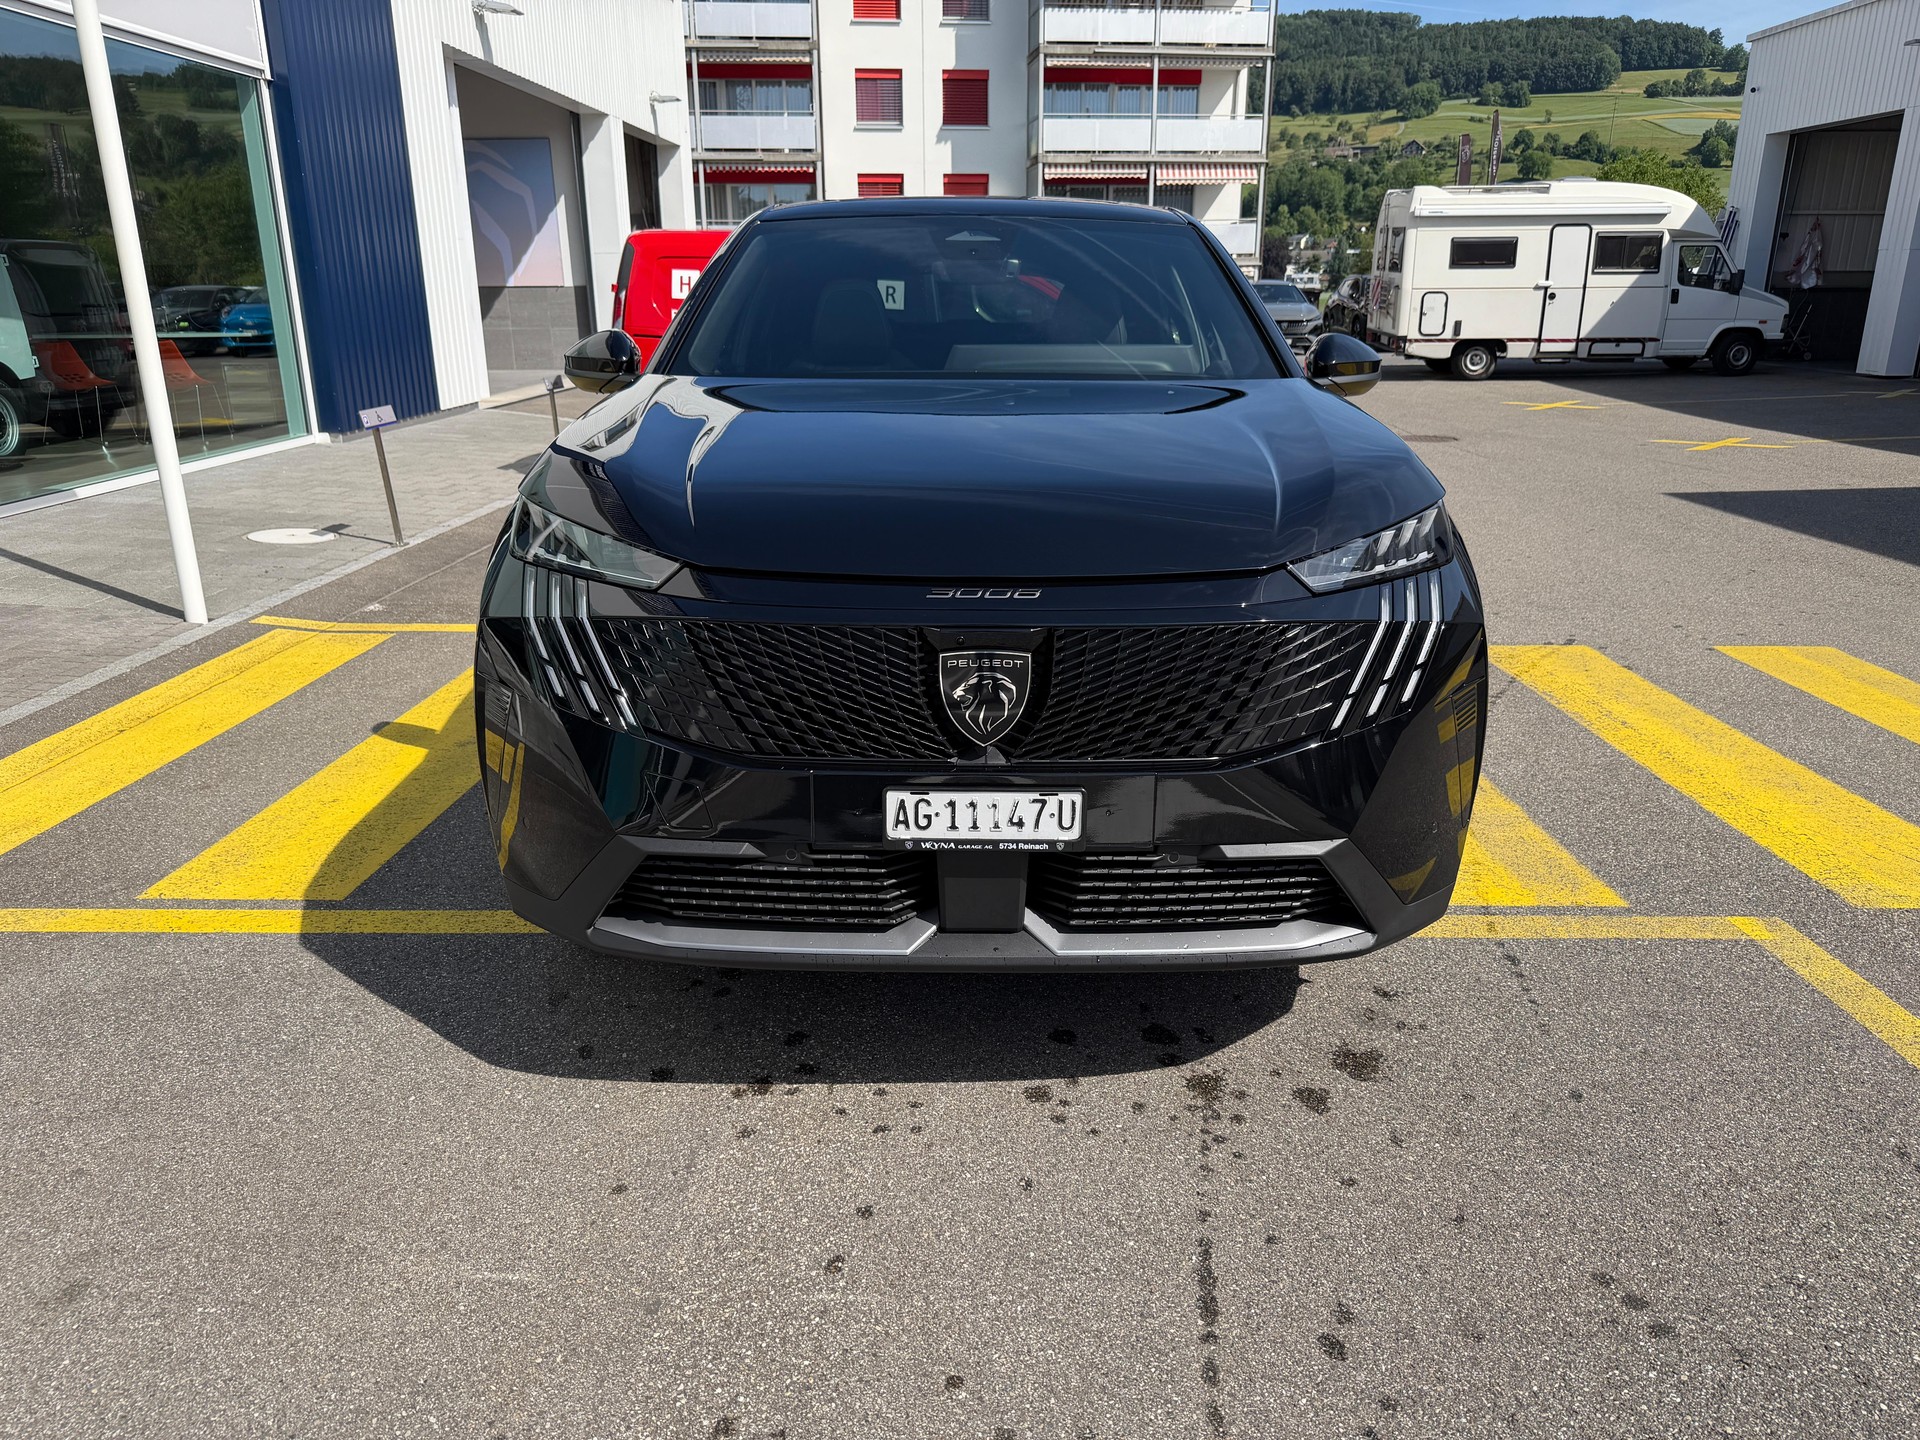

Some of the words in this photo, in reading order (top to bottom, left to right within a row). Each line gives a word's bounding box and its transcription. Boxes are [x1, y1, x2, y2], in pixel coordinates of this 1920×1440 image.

[680, 275, 691, 293] H
[885, 285, 897, 304] R
[926, 588, 1042, 599] 3008
[947, 659, 1024, 668] PEUGEOT
[999, 842, 1017, 850] 5734
[1018, 842, 1049, 850] Reinach
